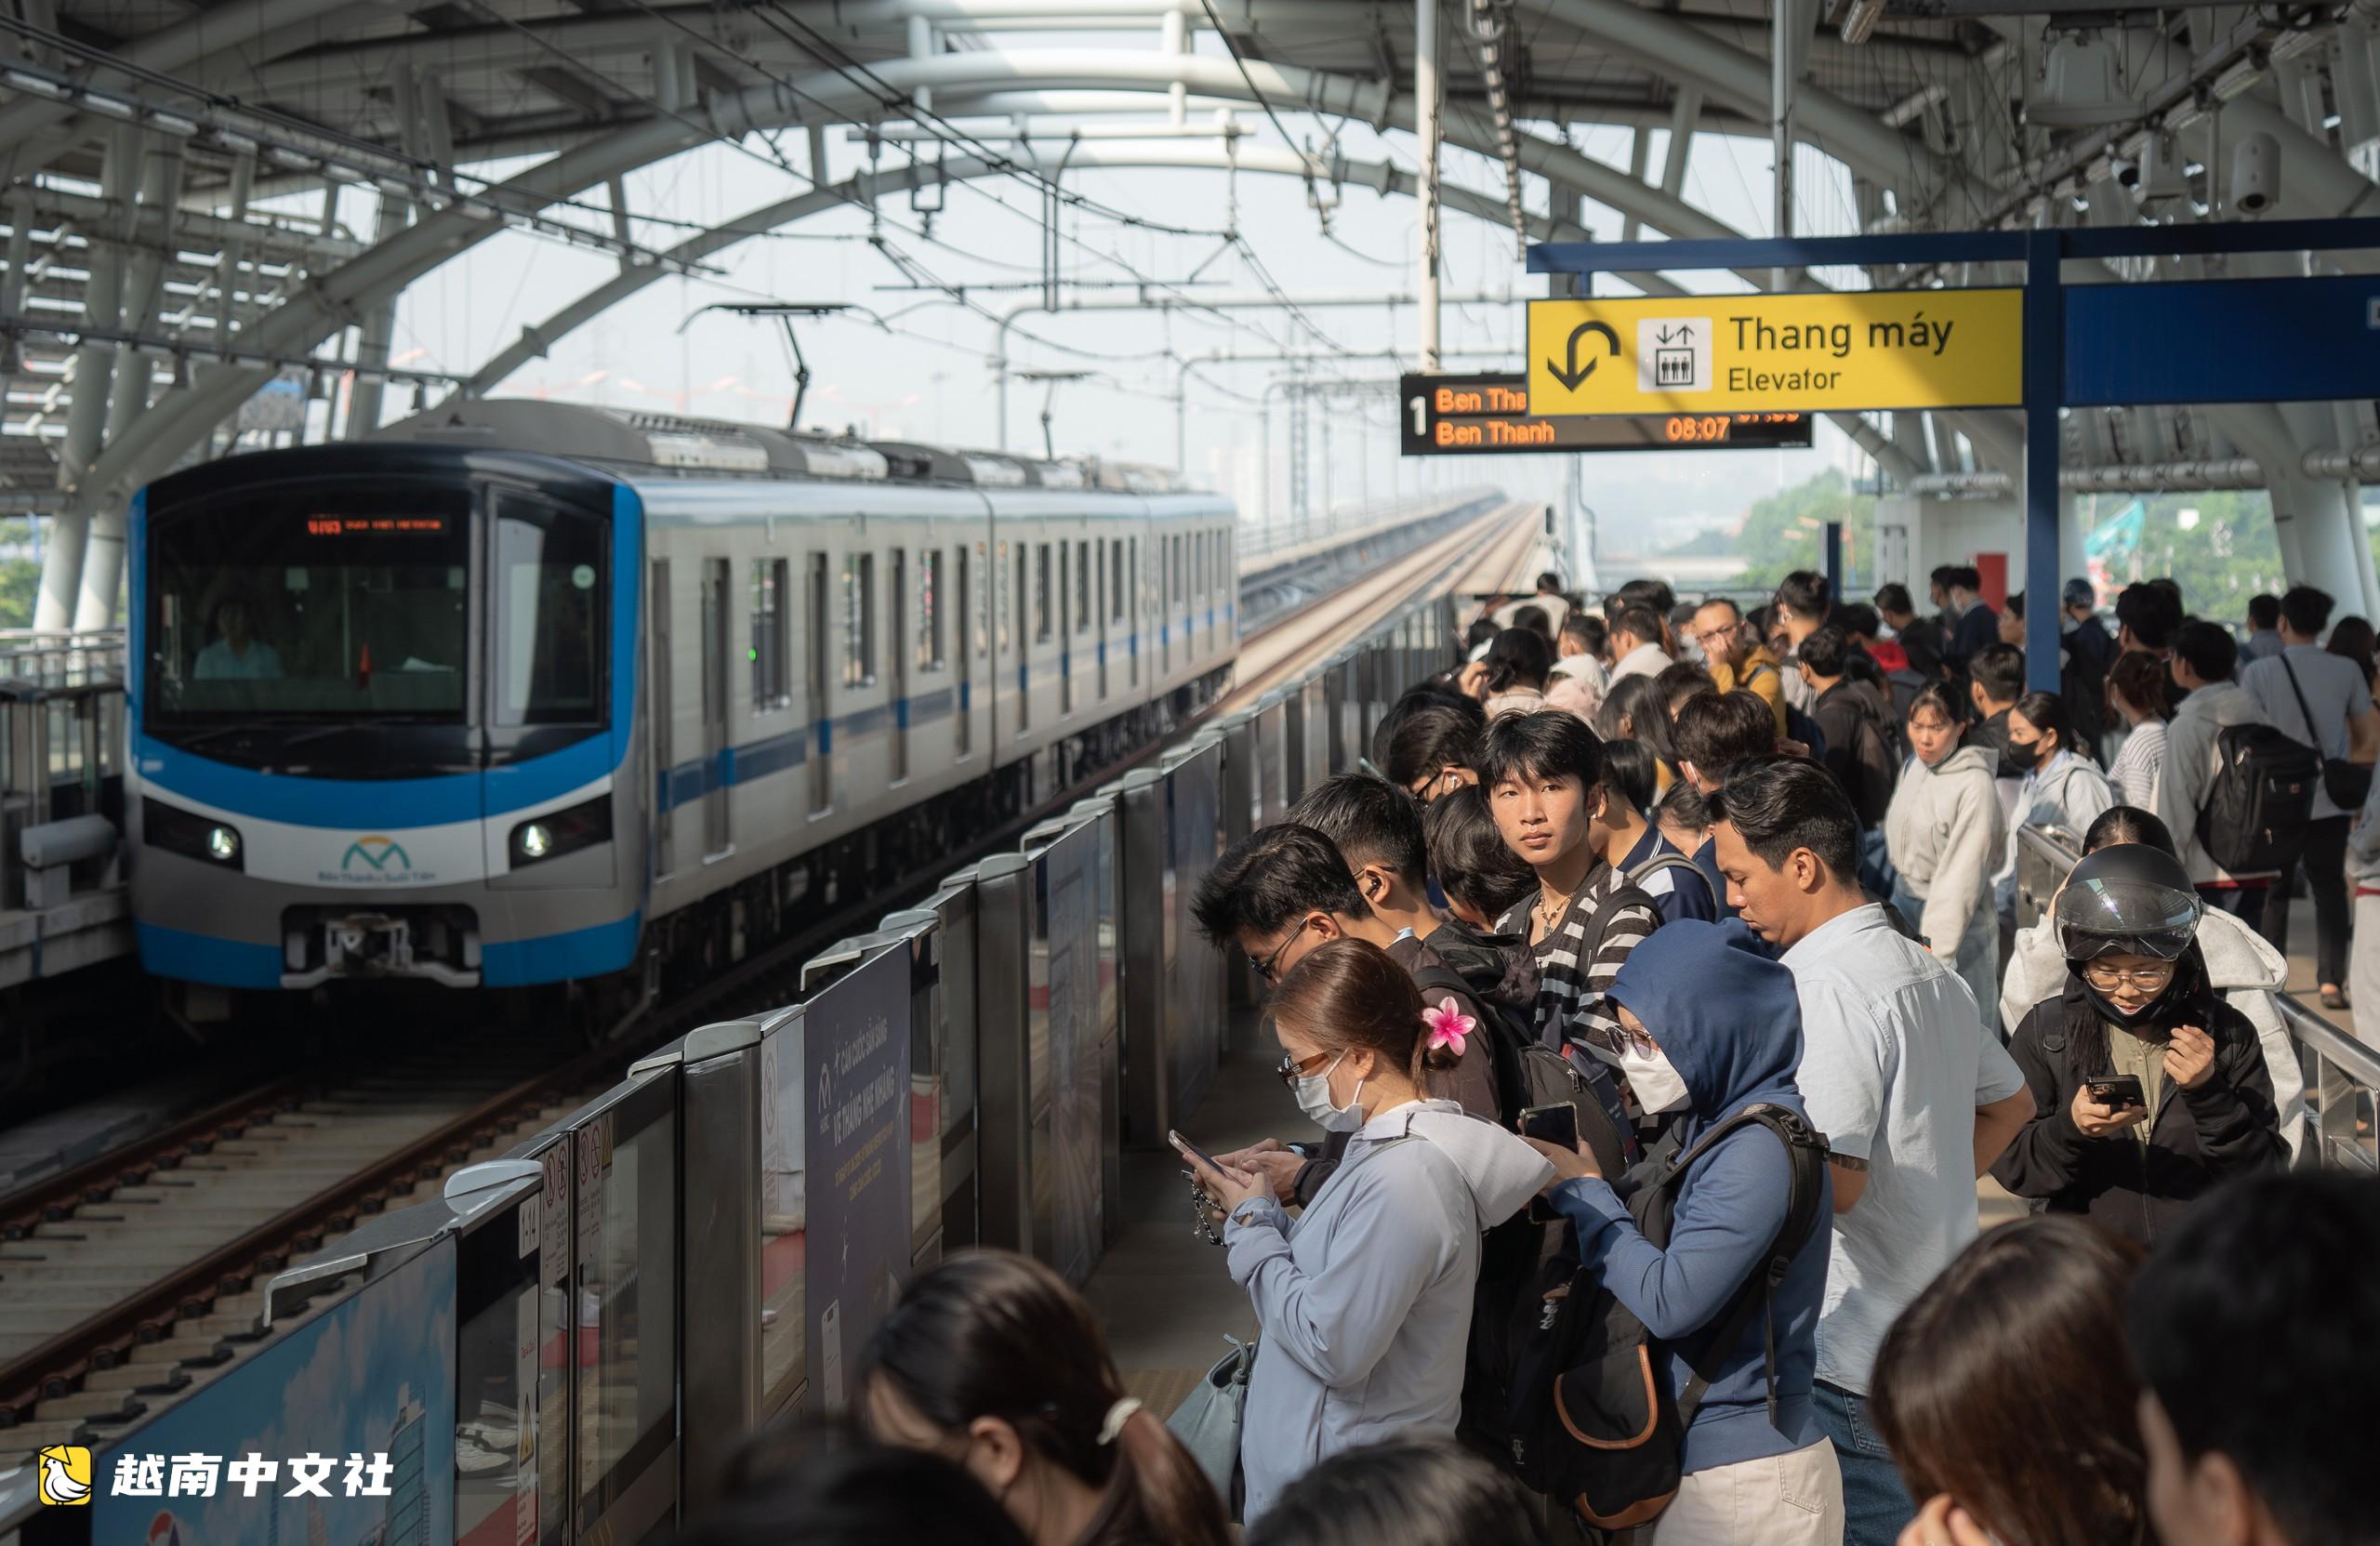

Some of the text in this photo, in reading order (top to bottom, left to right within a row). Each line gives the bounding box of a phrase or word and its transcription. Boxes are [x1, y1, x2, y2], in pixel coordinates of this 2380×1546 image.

[1729, 311, 1954, 358] Thang máy
[1728, 367, 1842, 391] Elevator
[1435, 388, 1482, 414] Ben
[1409, 395, 1427, 437] 1
[1665, 416, 1731, 443] 08:07
[1435, 418, 1555, 446] Ben Thanh
